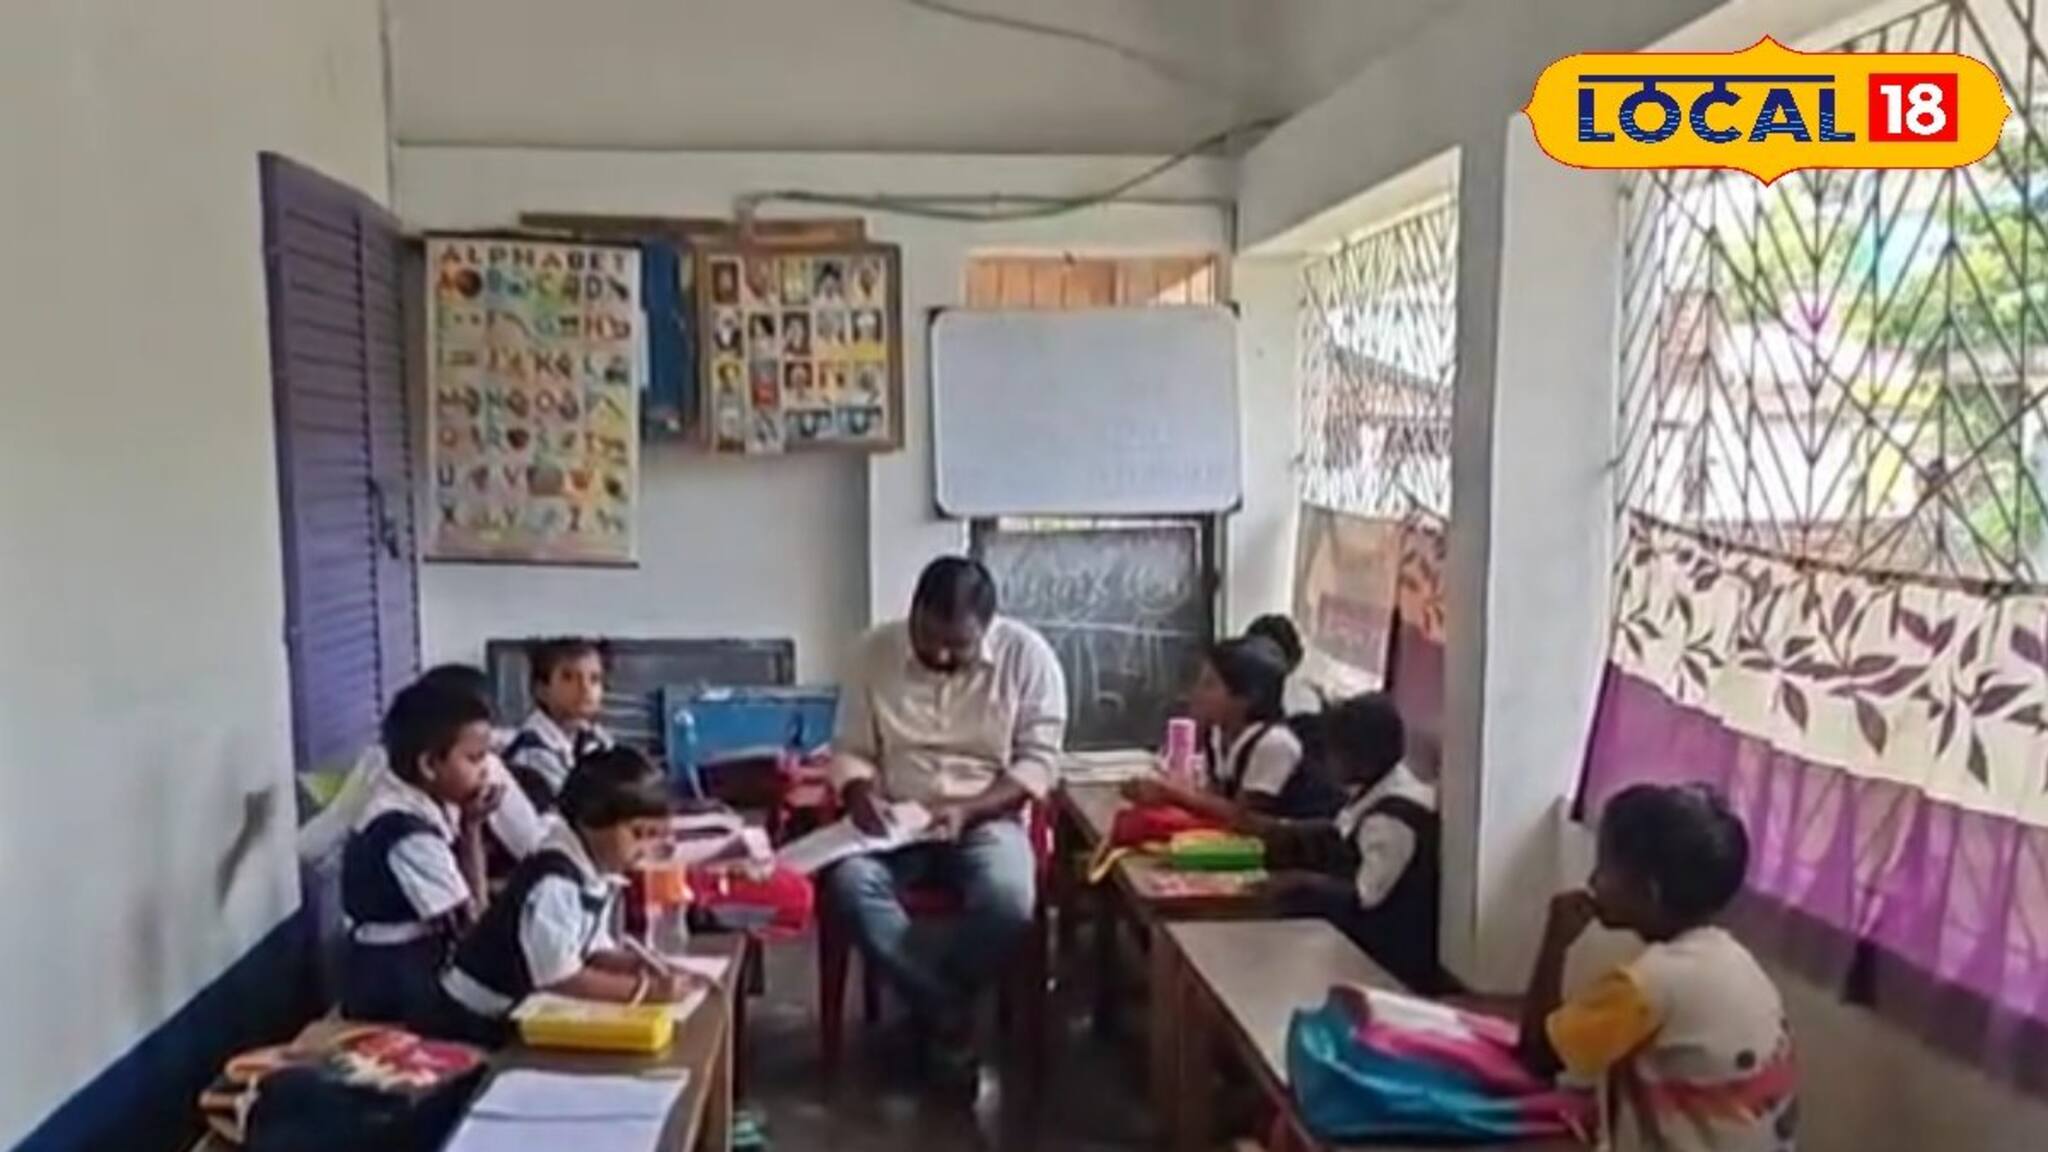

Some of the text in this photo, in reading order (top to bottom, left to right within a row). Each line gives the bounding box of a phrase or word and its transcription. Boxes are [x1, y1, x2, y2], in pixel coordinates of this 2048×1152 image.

[441, 245, 626, 270] ALPHABET
[586, 275, 603, 299] D
[584, 316, 603, 335] H
[535, 352, 554, 372] K
[439, 465, 454, 488] U
[504, 467, 522, 488] V
